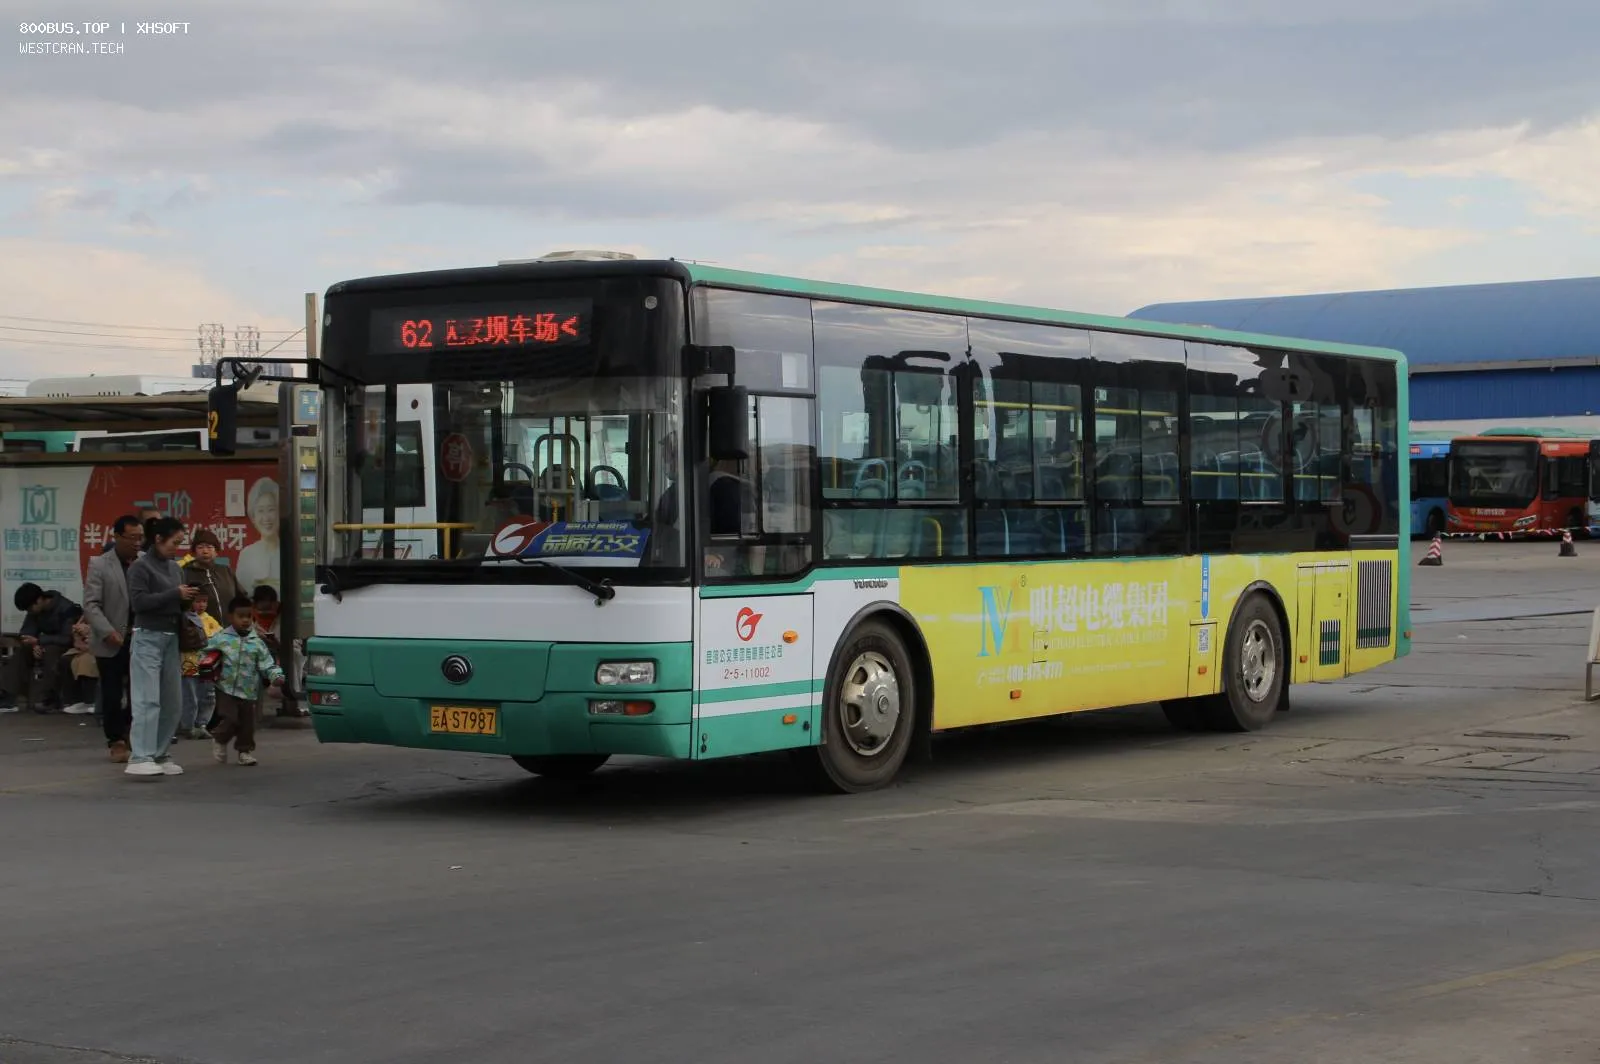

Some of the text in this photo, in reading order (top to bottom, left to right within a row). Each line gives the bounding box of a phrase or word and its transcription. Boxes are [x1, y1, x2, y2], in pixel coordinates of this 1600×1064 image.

[402, 319, 433, 348] 62
[133, 491, 193, 518] 一口价
[4, 528, 78, 552] 德韩口腔
[541, 533, 641, 554] 品质公交
[1028, 581, 1169, 634] 明超电缆集团
